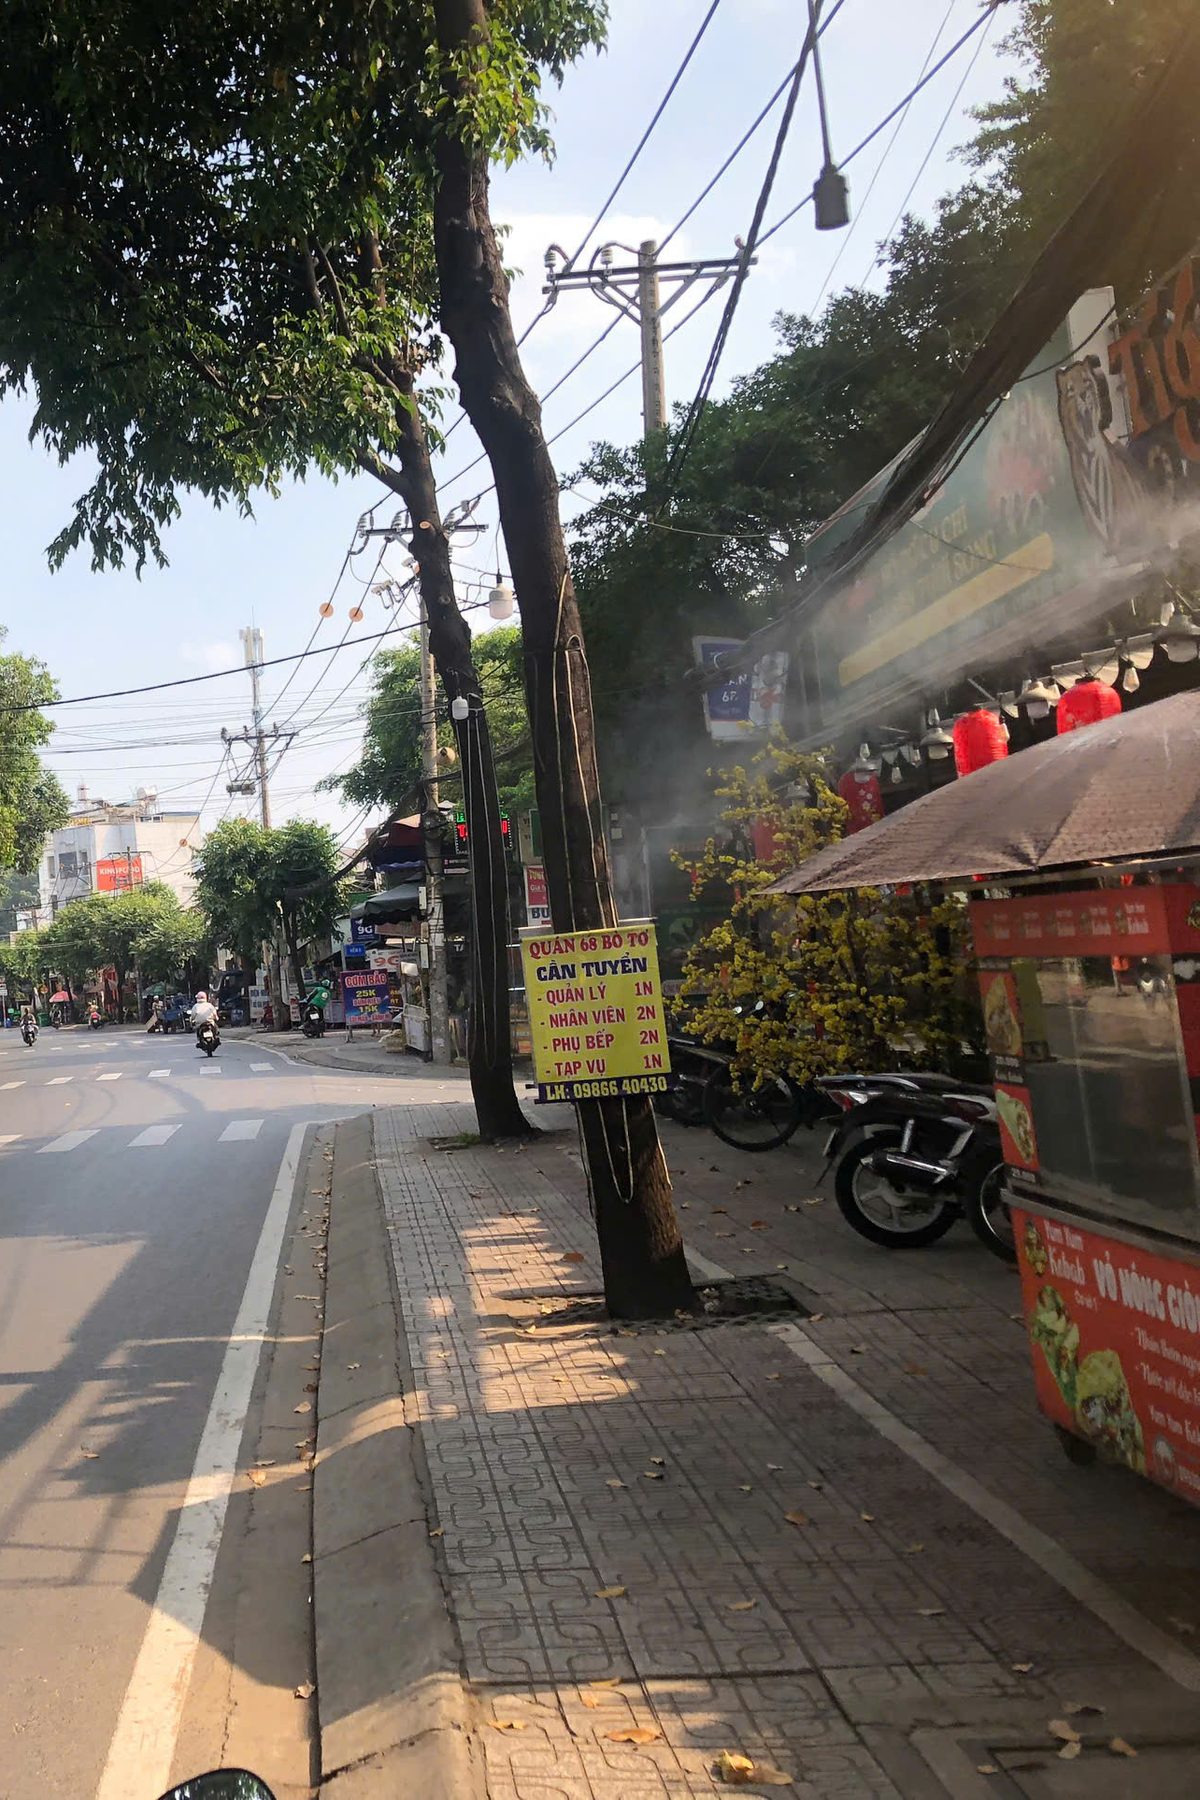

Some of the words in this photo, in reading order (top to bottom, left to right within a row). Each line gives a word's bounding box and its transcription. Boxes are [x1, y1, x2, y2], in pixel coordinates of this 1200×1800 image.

[357, 925, 373, 934] 9G
[529, 936, 576, 959] QUÁN
[580, 937, 598, 952] 68
[602, 931, 623, 949] BÒ
[627, 929, 650, 947] TƠ
[536, 959, 576, 981] CẦN
[582, 952, 648, 978] TUYỂN
[356, 989, 376, 997] 25K
[546, 983, 585, 1006] QUẢN
[589, 981, 606, 1001] LÝ
[635, 981, 653, 996] 1N
[549, 1008, 588, 1029] NHÂN
[593, 1006, 625, 1025] VIÊN
[636, 1005, 656, 1021] 2N
[552, 1036, 580, 1055] PHỤ
[586, 1029, 615, 1050] BẾP
[639, 1029, 659, 1045] 2N
[555, 1061, 582, 1081] TẠP
[586, 1059, 606, 1076] VỤ
[643, 1054, 662, 1069] 1N
[546, 1084, 571, 1100] LH:
[573, 1079, 618, 1098] 09866
[622, 1076, 668, 1095] 40430
